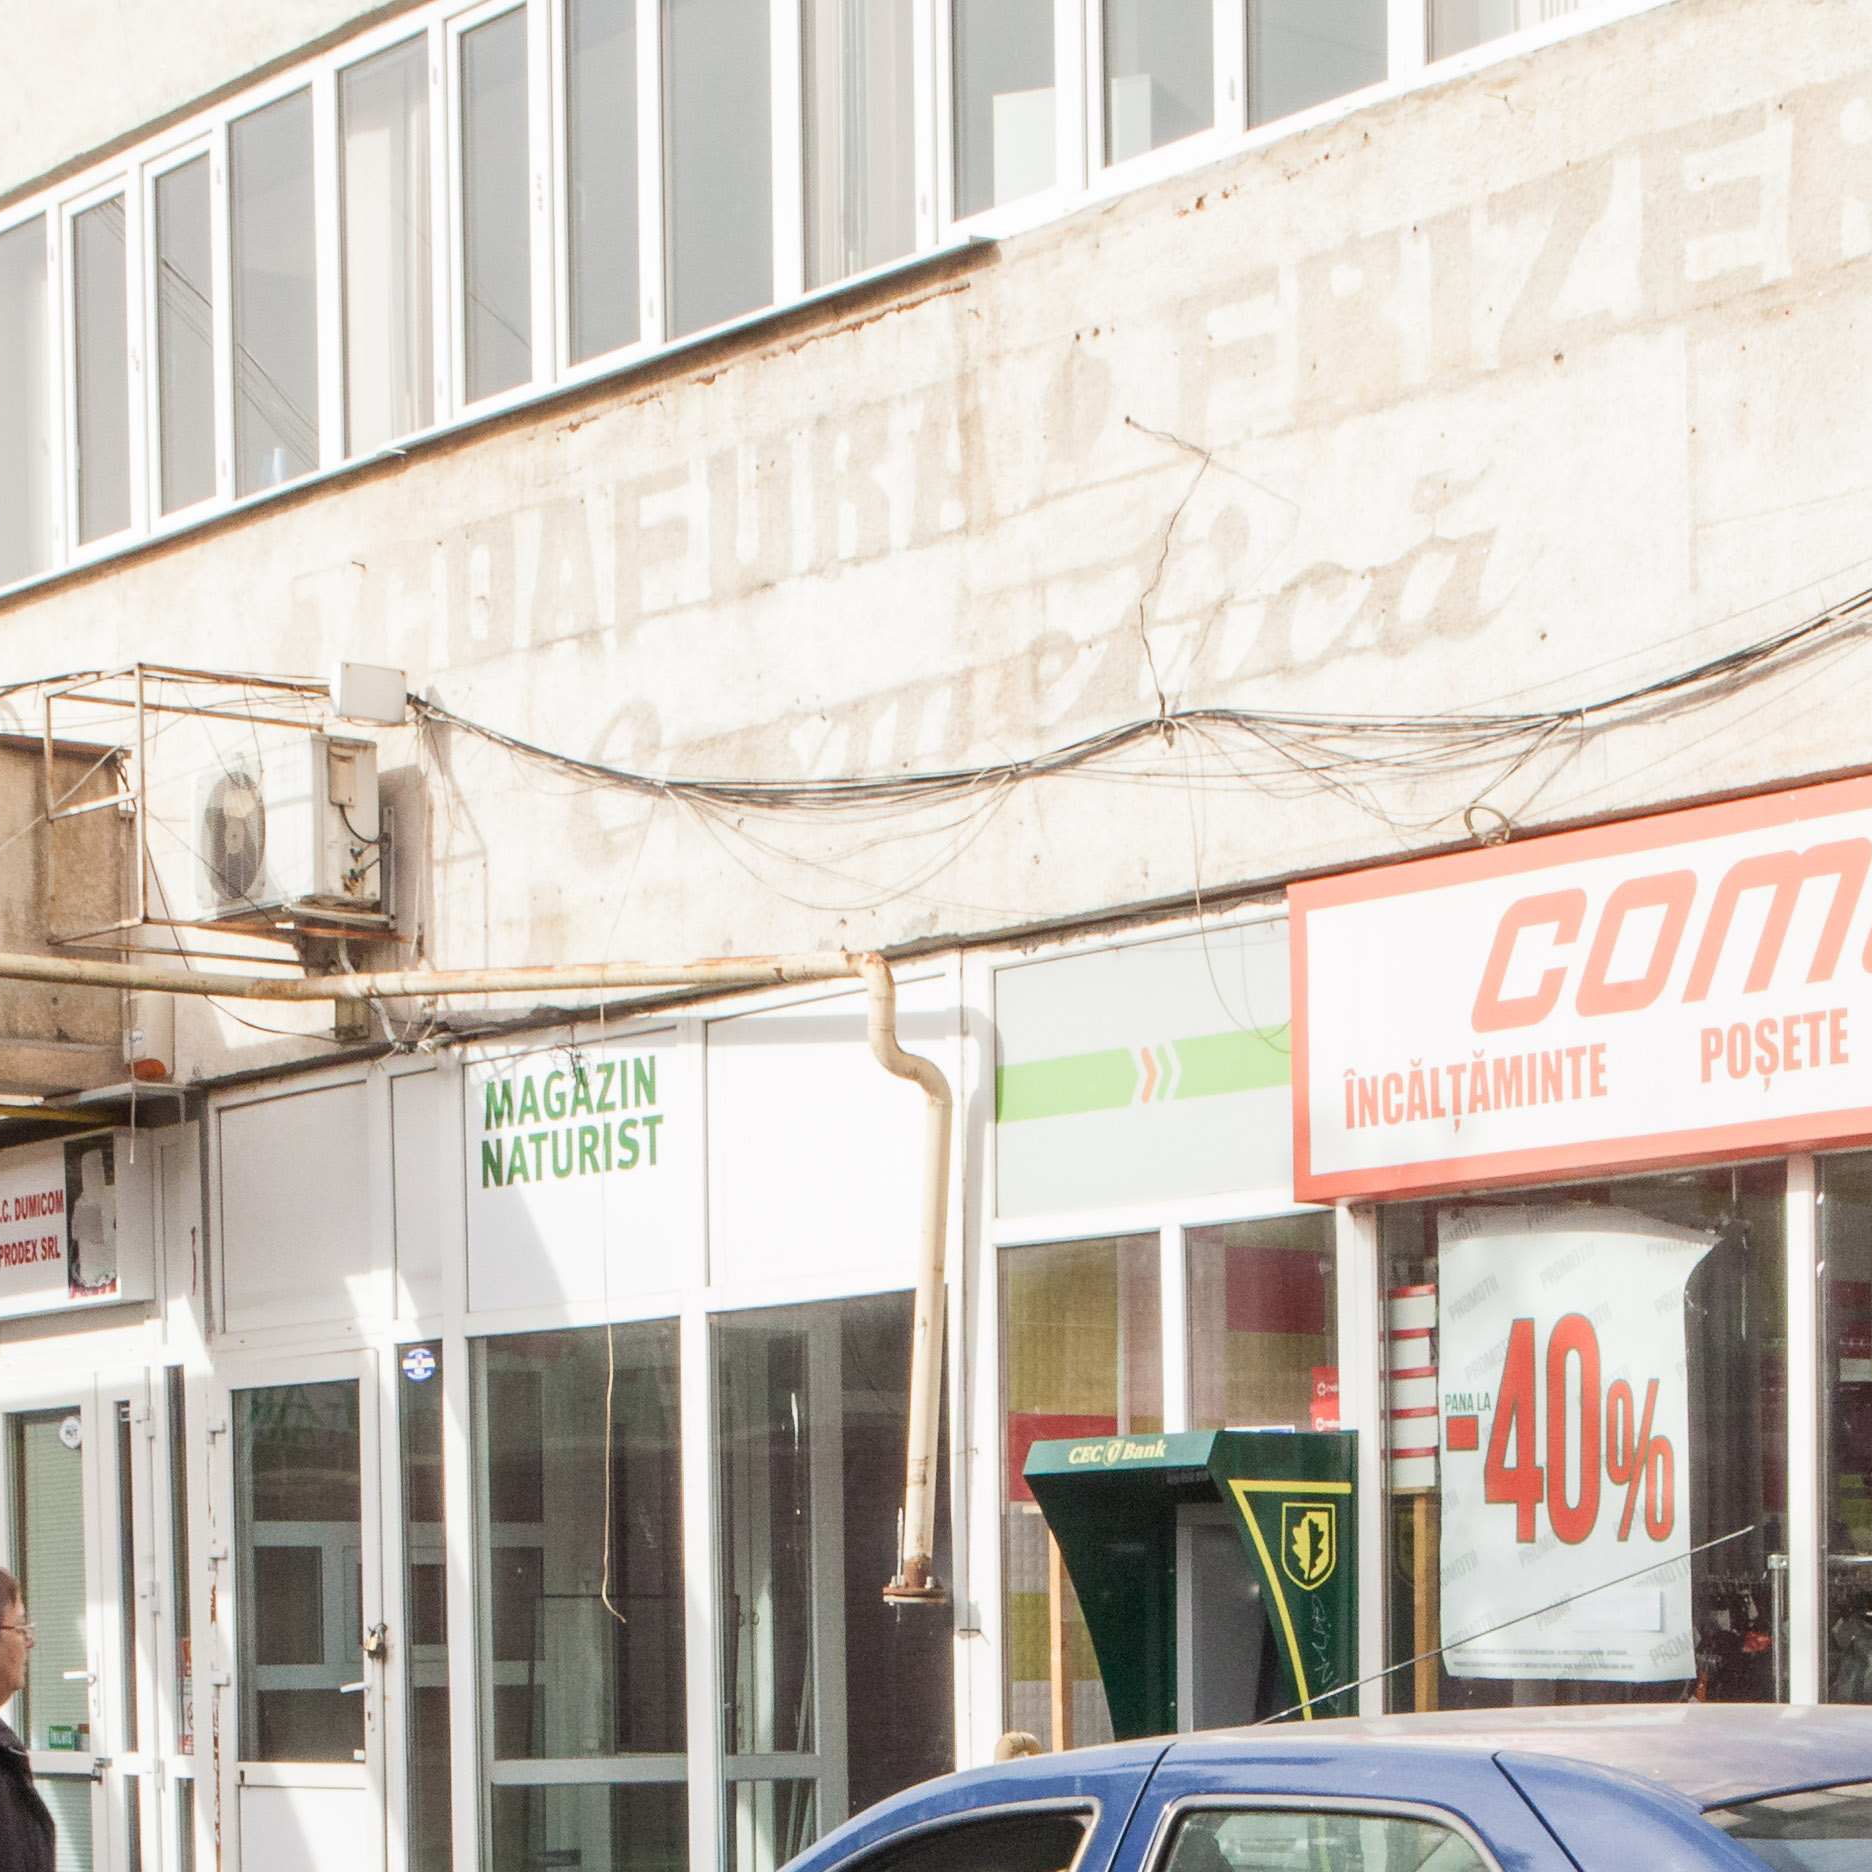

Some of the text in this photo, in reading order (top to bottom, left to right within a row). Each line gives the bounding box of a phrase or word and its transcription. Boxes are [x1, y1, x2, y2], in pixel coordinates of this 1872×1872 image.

[482, 1055, 658, 1133] MAGAZIN
[1343, 1042, 1608, 1133] ÎNCĂLȚĂMINTE
[1699, 1006, 1850, 1092] POȘETE
[480, 1114, 665, 1190] NATURIST
[14, 1189, 64, 1221] DUMICOM
[40, 1235, 61, 1261] SRL
[1445, 1391, 1491, 1413] PANA LA
[1445, 1312, 1675, 1545] -40%
[1068, 1438, 1168, 1464] CEC Bank
